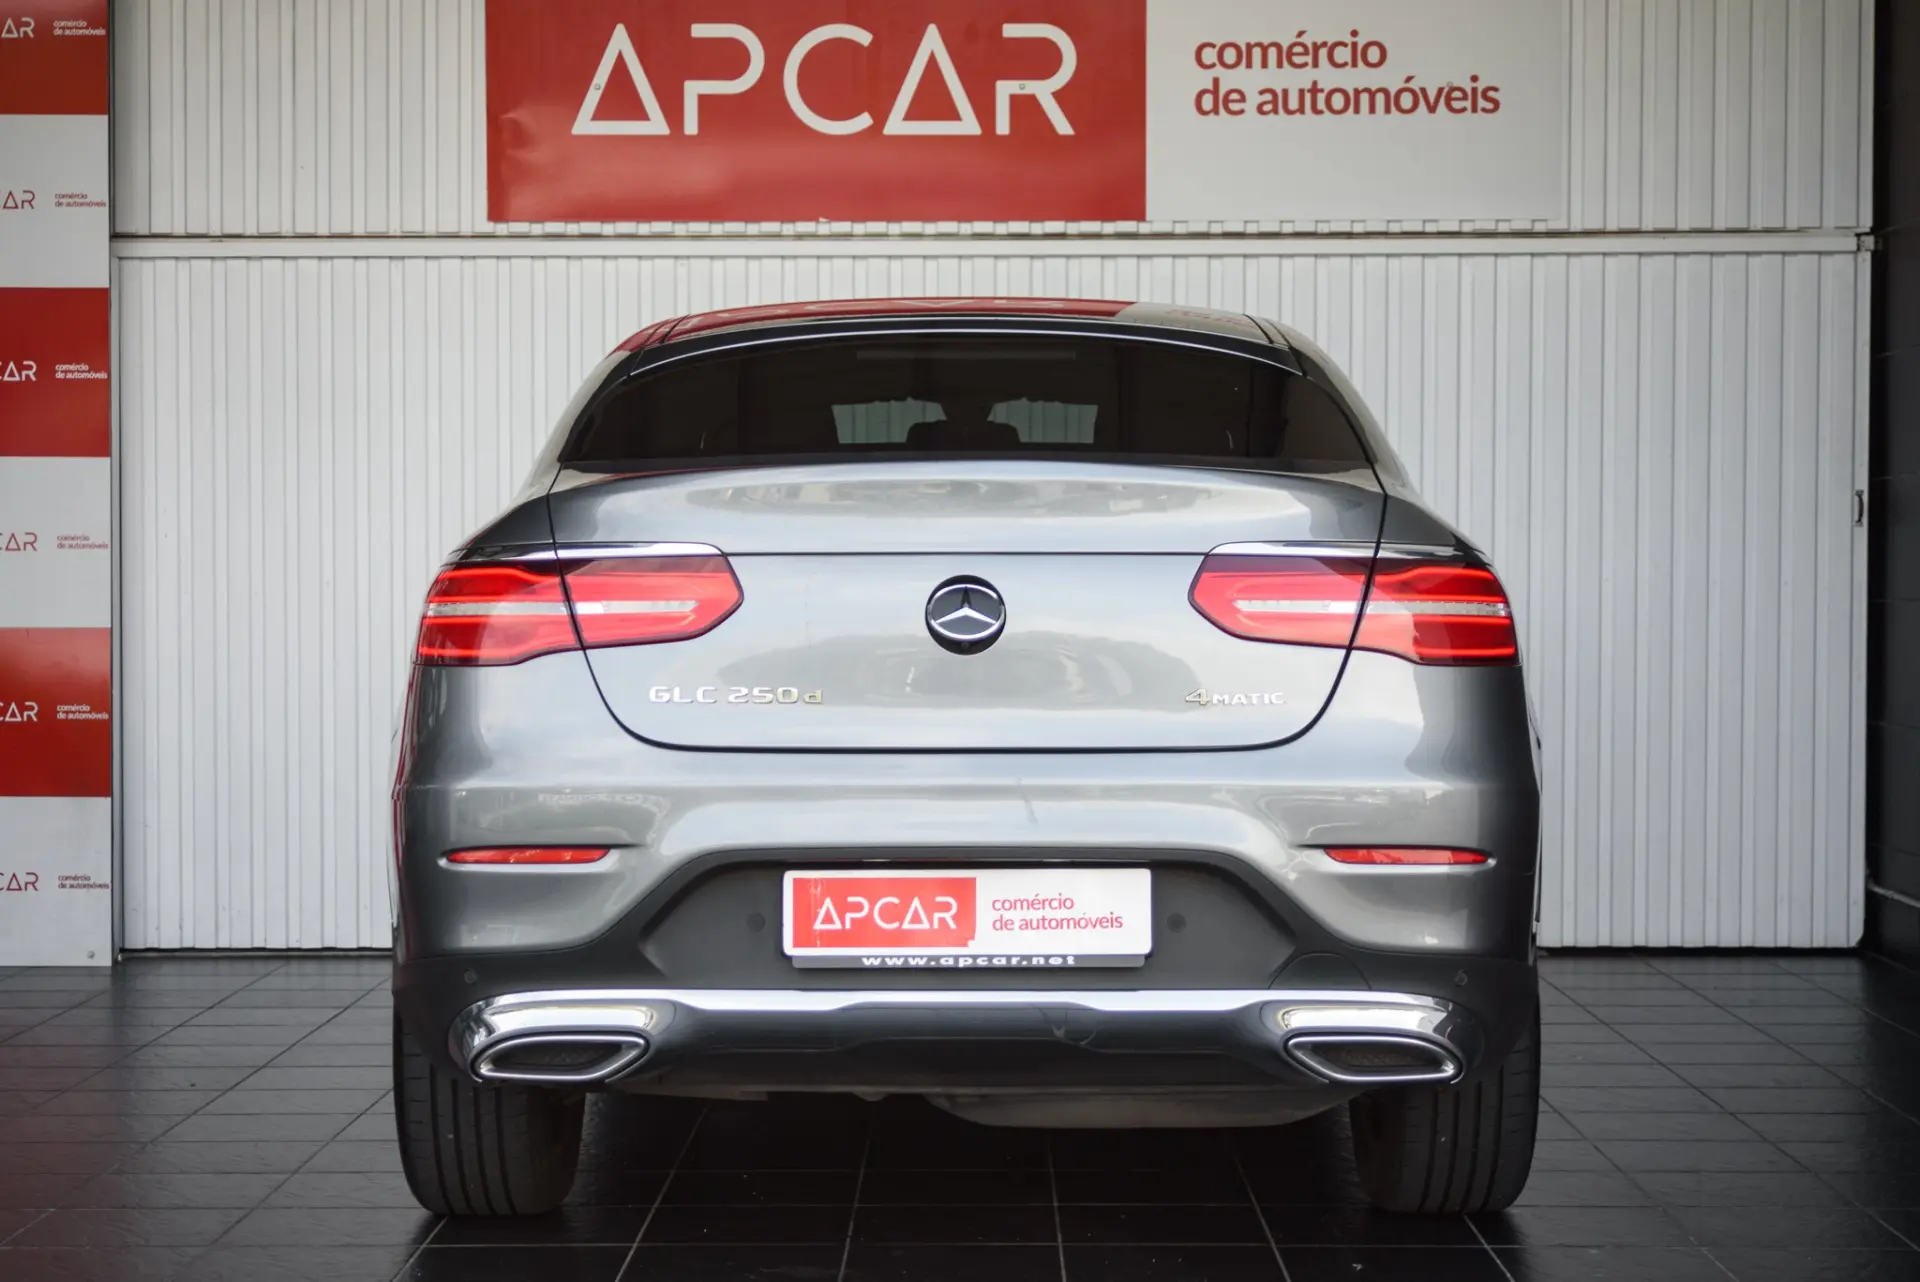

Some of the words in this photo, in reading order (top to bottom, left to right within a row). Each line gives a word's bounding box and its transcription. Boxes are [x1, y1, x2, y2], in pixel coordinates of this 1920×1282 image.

[1194, 29, 1388, 70] comércio
[571, 23, 1077, 136] APCAR
[1194, 76, 1246, 116] de
[1256, 74, 1501, 116] automóveis
[0, 190, 36, 210] AR
[0, 360, 37, 381] AR
[0, 532, 38, 551] AR
[649, 686, 717, 704] GLC
[1185, 688, 1285, 706] 4MATIC
[0, 702, 38, 722] AR
[0, 872, 39, 891] AR
[992, 892, 1075, 912] comércio
[813, 896, 957, 930] APCAR
[992, 914, 1015, 931] de
[1018, 911, 1123, 931] automóveis
[861, 956, 1076, 967] www.apcar.net
